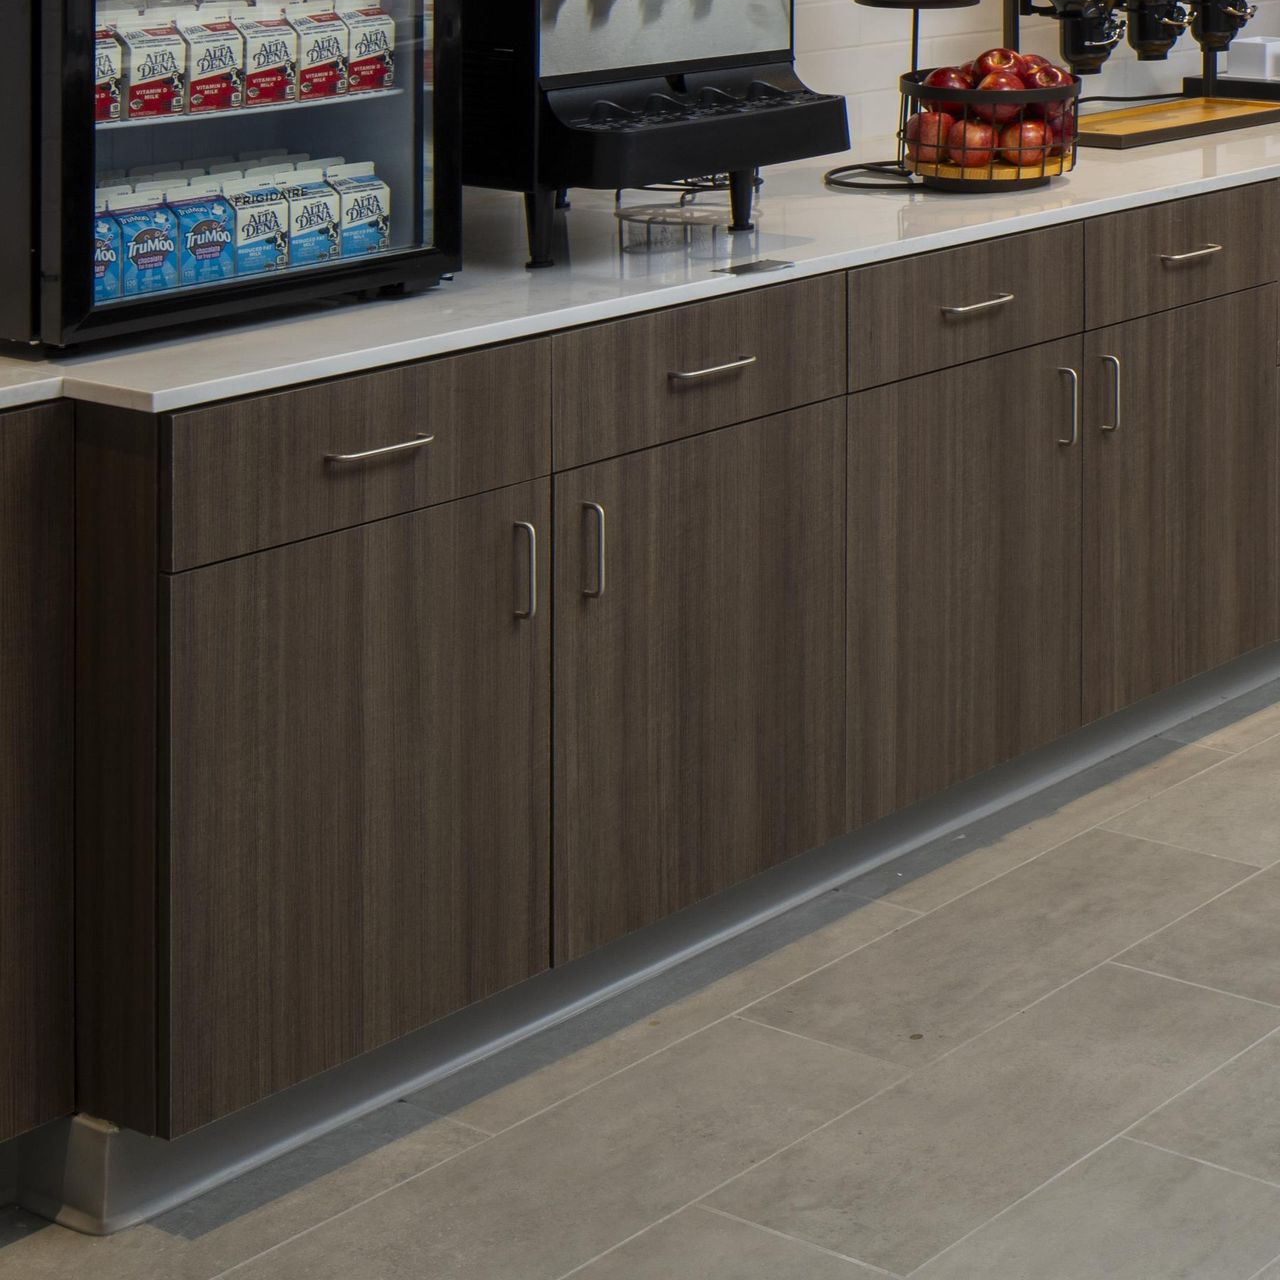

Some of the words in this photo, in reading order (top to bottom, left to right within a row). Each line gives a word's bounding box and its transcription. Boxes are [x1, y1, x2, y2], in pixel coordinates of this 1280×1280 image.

[313, 37, 340, 51] ALTA
[361, 30, 387, 44] ALTA
[204, 46, 233, 59] ALTA
[260, 40, 288, 54] ALTA
[306, 46, 342, 62] DENA
[355, 39, 390, 55] DENA
[145, 51, 175, 65] ALTA
[197, 55, 236, 72] DENA
[253, 50, 290, 66] DENA
[137, 61, 178, 77] DENA
[234, 187, 309, 207] FRIGIDAIRE
[353, 195, 380, 209] ALTA
[302, 201, 330, 217] ALTA
[346, 204, 382, 221] DENA
[249, 211, 278, 225] ALTA
[295, 210, 332, 228] DENA
[242, 220, 280, 238] DENA
[185, 230, 231, 248] TruMoo
[127, 239, 175, 258] TruMoo
